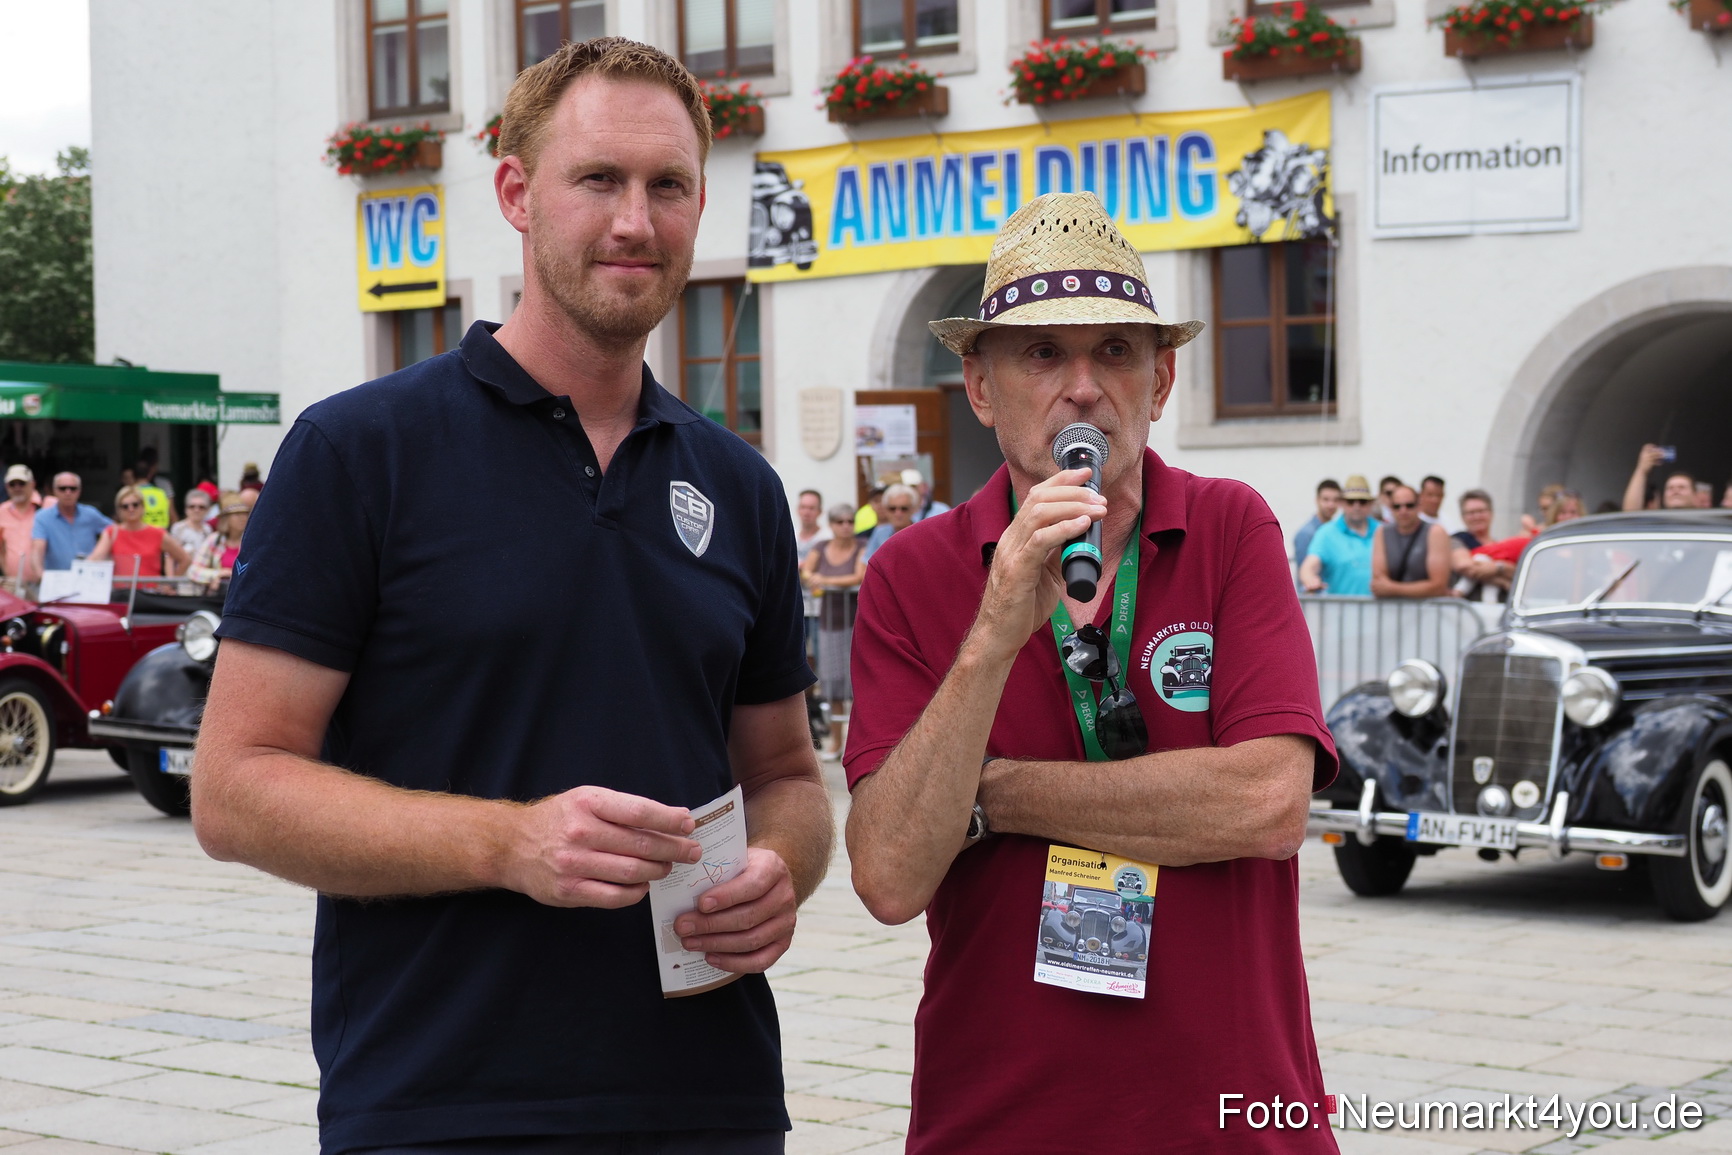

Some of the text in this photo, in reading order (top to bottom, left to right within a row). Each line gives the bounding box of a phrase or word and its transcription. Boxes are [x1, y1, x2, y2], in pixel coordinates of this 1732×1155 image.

[1383, 138, 1562, 174] Information
[828, 130, 1218, 250] ANMELDUNG
[363, 194, 440, 270] WC
[0, 396, 16, 415] u
[143, 399, 217, 420] Neumarkter
[1119, 592, 1130, 622] DEKRA
[1140, 622, 1186, 669] NEUMARKTER
[1080, 702, 1096, 732] DEKRA
[1420, 818, 1515, 844] AN FW1H
[1049, 868, 1101, 881] Manfred Schreiner
[1051, 854, 1108, 871] Organisation
[1047, 960, 1134, 978] www.oldtimertreffen-neumarkt.de
